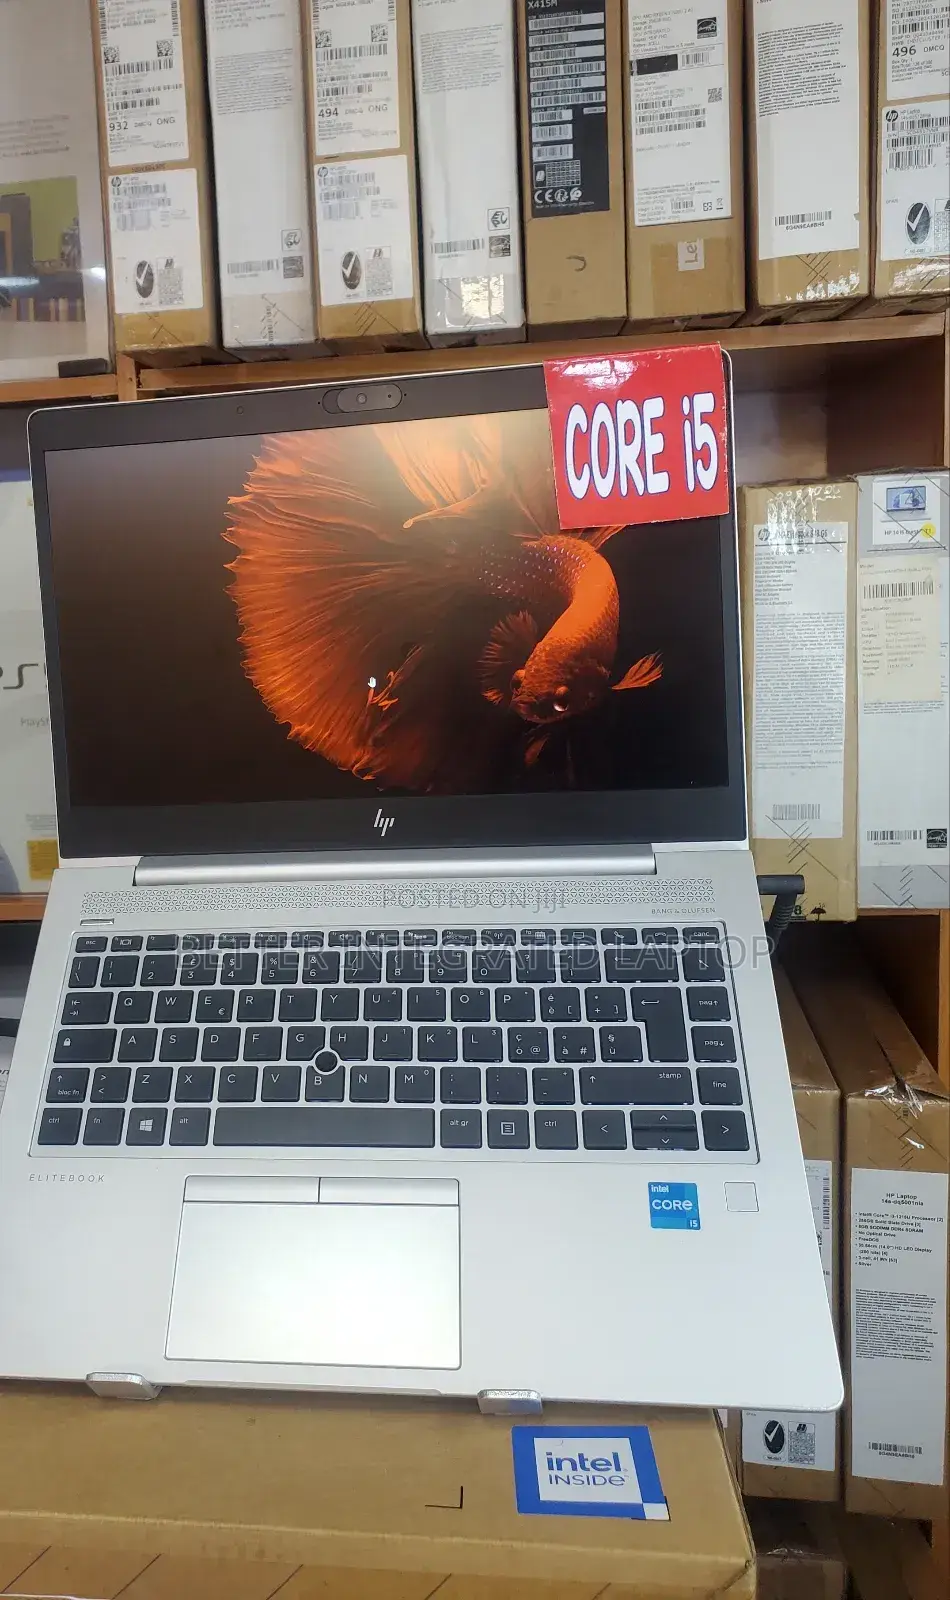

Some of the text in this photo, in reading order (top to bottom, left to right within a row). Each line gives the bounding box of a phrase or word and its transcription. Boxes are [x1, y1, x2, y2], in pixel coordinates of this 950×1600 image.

[892, 45, 917, 57] 496
[318, 108, 339, 118] 494
[368, 104, 388, 113] ONG
[109, 117, 176, 132] 932 ONG
[564, 392, 719, 500] CORE i5
[374, 808, 395, 837] hp
[270, 957, 277, 965] %
[310, 956, 317, 964] &
[147, 972, 154, 980] 2
[269, 970, 275, 978] 5
[310, 969, 316, 977] 6
[124, 998, 133, 1006] Q
[165, 997, 177, 1006] W
[205, 996, 212, 1005] E
[246, 996, 254, 1005] R
[287, 996, 295, 1004] T
[329, 995, 338, 1003] Y
[372, 995, 381, 1003] U
[460, 994, 469, 1003] O
[504, 995, 512, 1004] P
[218, 1008, 225, 1016] €
[128, 1036, 137, 1045] A
[169, 1035, 177, 1044] S
[210, 1034, 219, 1043] D
[252, 1034, 260, 1043] F
[295, 1034, 305, 1042] G
[338, 1033, 347, 1042] H
[382, 1034, 388, 1043] J
[426, 1034, 435, 1043] K
[471, 1035, 479, 1044] L
[530, 1046, 541, 1054] @
[580, 1047, 588, 1055] #
[142, 1075, 151, 1084] Z
[184, 1075, 193, 1084] X
[227, 1074, 236, 1083] C
[270, 1074, 280, 1083] V
[314, 1076, 322, 1085] B
[358, 1074, 368, 1083] N
[404, 1075, 414, 1084] M
[659, 1072, 682, 1080] stamp
[29, 1174, 105, 1182] ELITEBOOK
[650, 1184, 669, 1193] intel
[690, 1220, 698, 1228] i5
[546, 1452, 621, 1472] intel
